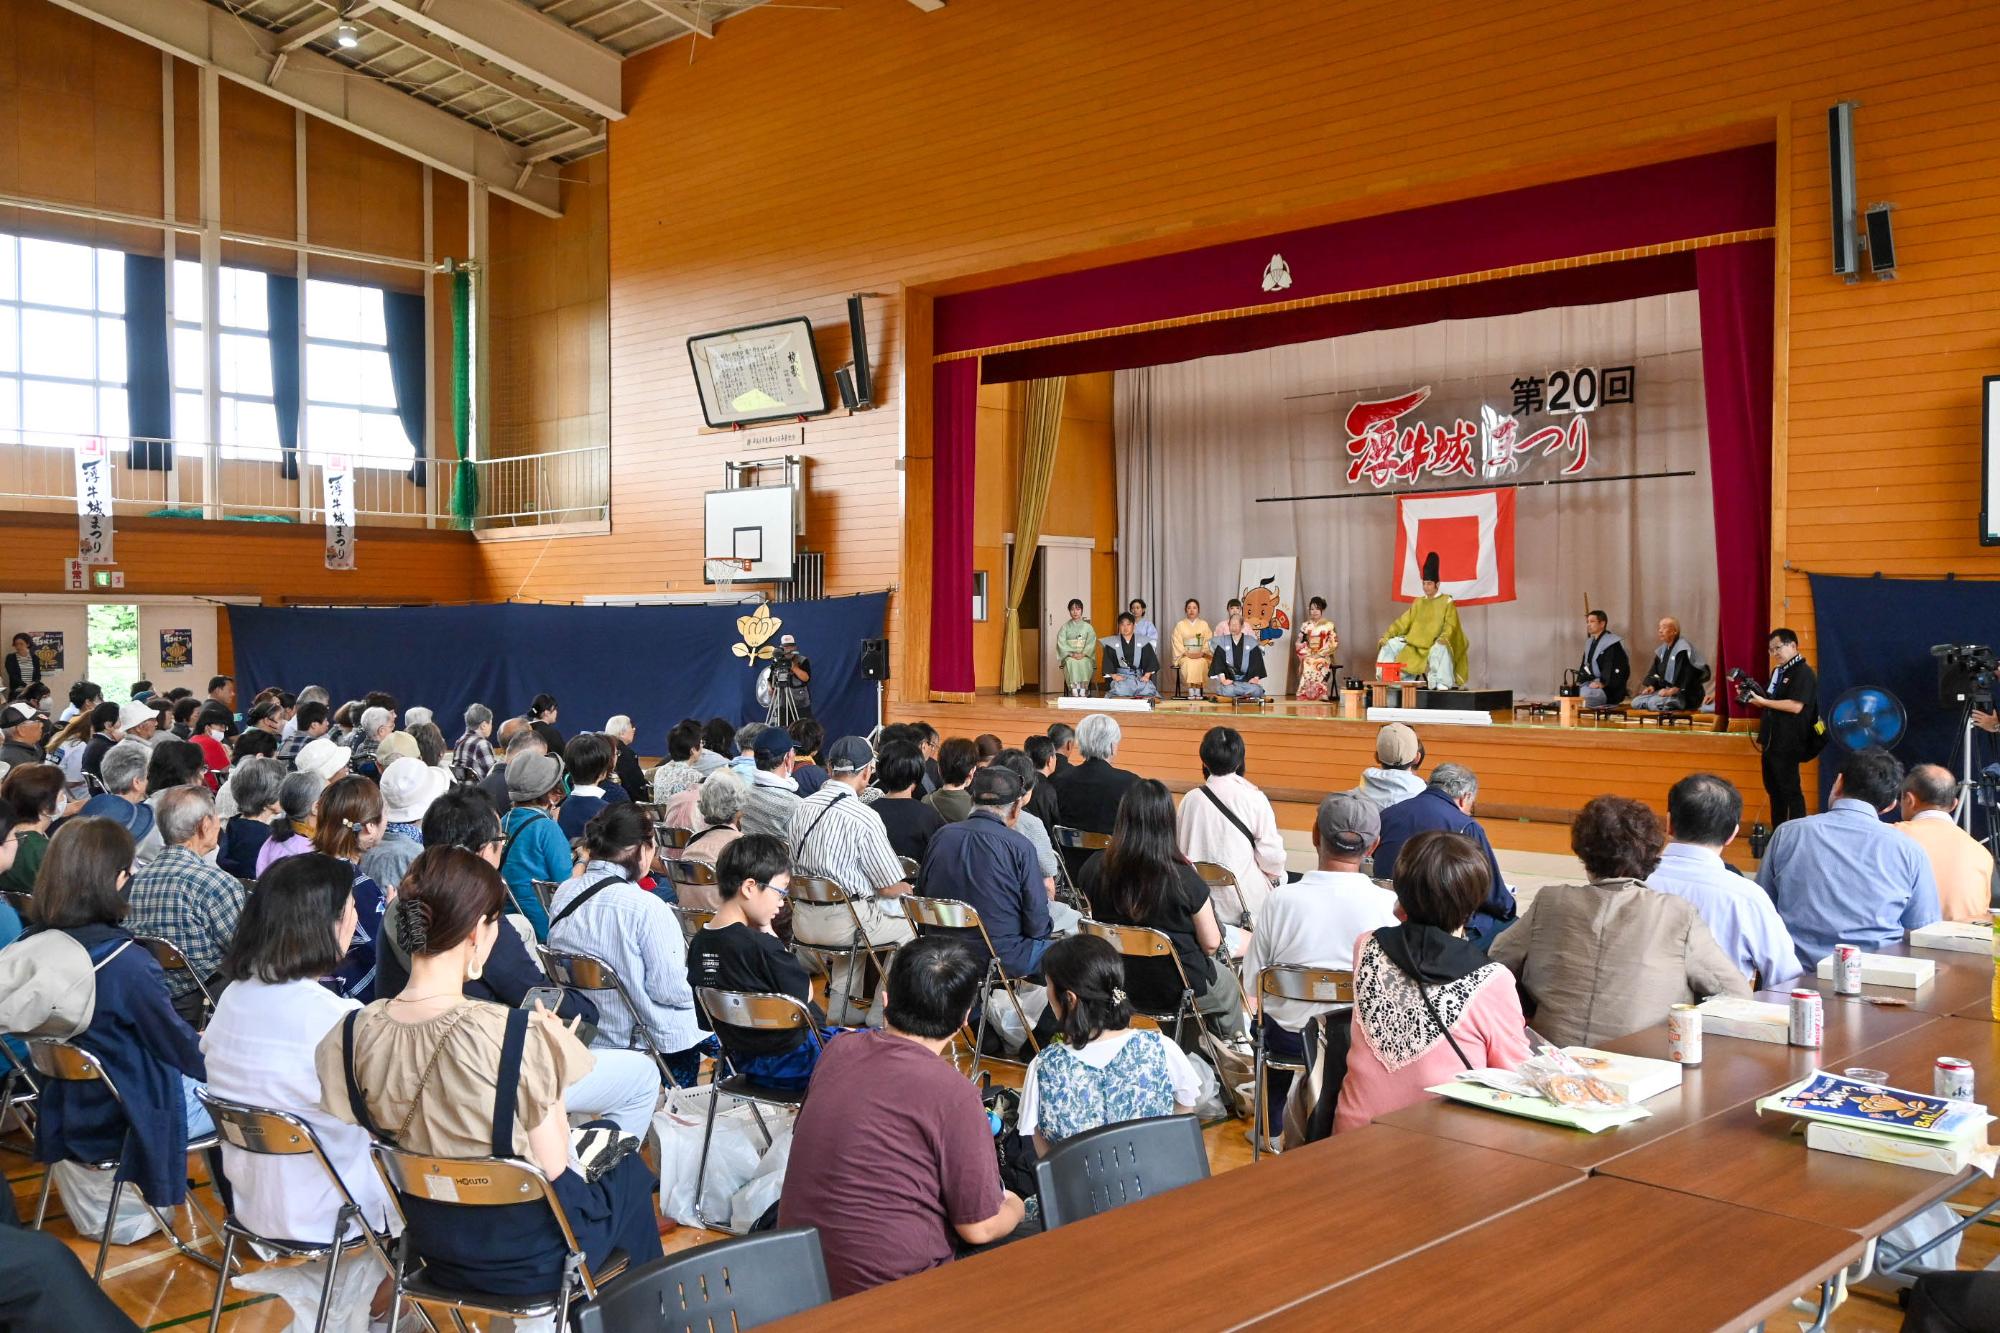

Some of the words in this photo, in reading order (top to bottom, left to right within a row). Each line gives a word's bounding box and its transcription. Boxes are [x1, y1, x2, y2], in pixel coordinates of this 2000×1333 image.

[1510, 366, 1635, 416] 第20回
[1346, 385, 1590, 488] 浮牛城まつり
[82, 459, 106, 554] 浮牛城まつり
[328, 474, 348, 560] 浮牛城まつり
[71, 560, 82, 589] 非常口
[455, 1178, 489, 1186] HOKUTO
